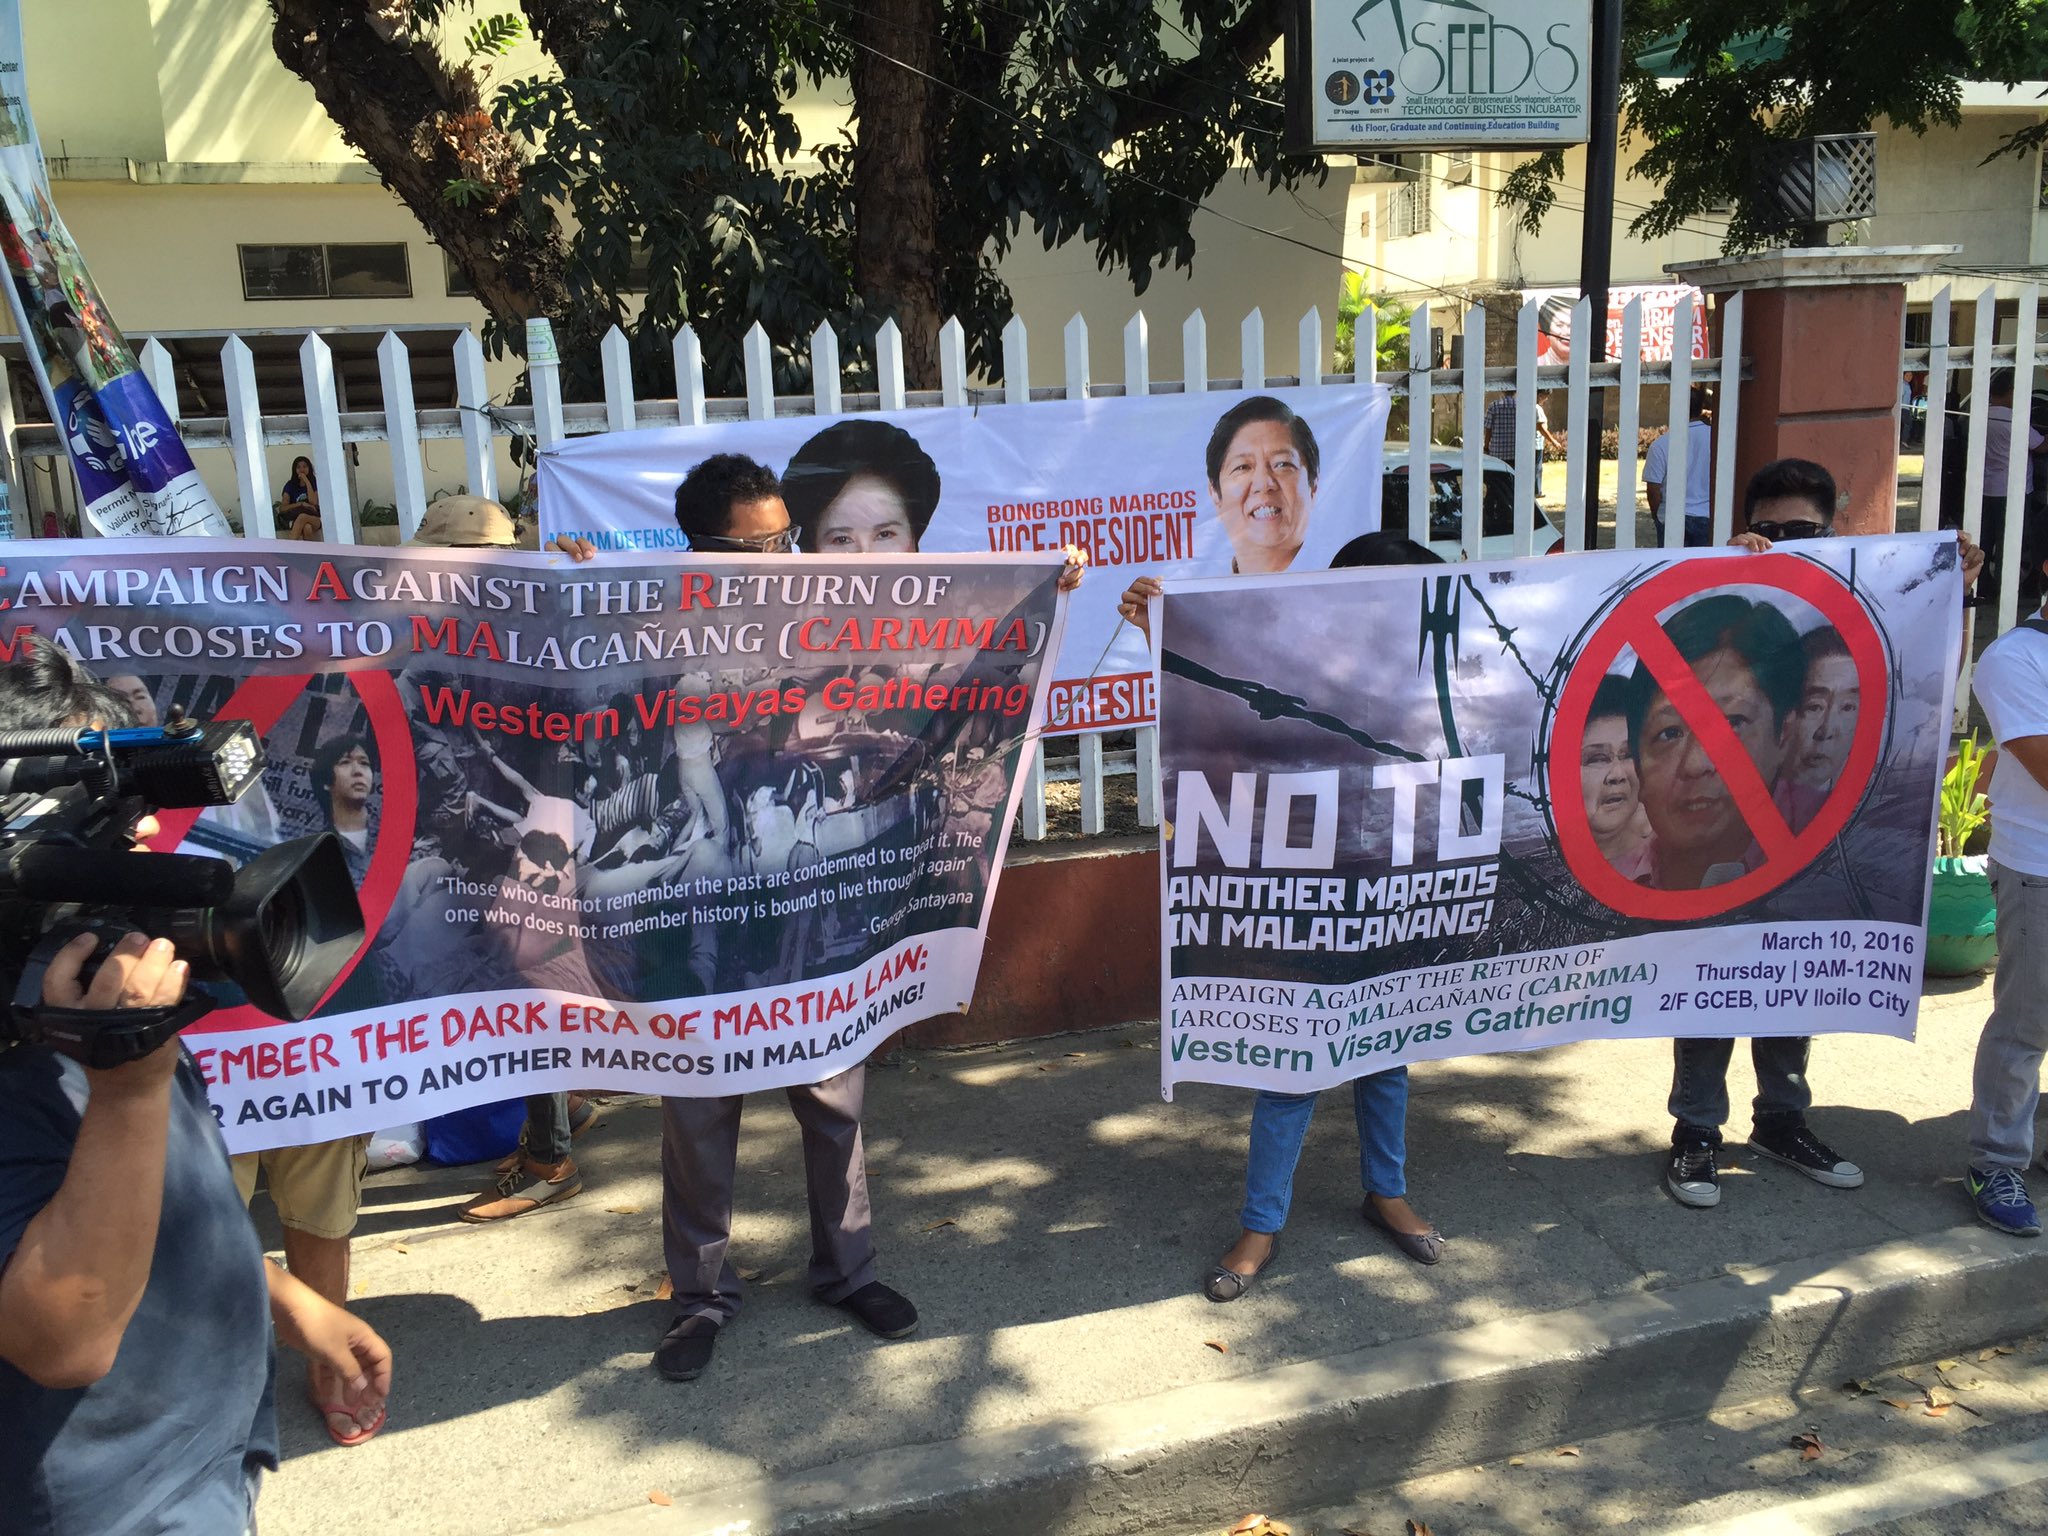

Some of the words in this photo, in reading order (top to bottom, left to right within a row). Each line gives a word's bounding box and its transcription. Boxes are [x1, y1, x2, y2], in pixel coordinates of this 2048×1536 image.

[1401, 105, 1469, 115] TECHNOLOGY
[1473, 104, 1522, 114] BUSINESS
[1525, 104, 1582, 114] INCUBATOR
[1406, 96, 1423, 105] Small
[1424, 96, 1454, 106] Enterprise
[1455, 96, 1467, 105] and
[1467, 95, 1513, 106] Entrepreneurial
[1514, 95, 1552, 105] Development
[1553, 95, 1577, 104] Services
[1350, 123, 1364, 132] 4th
[1365, 123, 1389, 133] Floor,
[1390, 122, 1427, 132] Graduate
[1427, 122, 1443, 131] and
[1527, 120, 1560, 131] Building
[95, 494, 131, 518] Permit
[106, 506, 140, 532] Validity
[987, 497, 1103, 523] BONGBONG
[1109, 490, 1197, 514] MARCOS
[615, 528, 690, 550] DEFENSO
[987, 510, 1197, 568] VICE-PRESIDENT
[0, 564, 288, 611] AMPAIGN
[305, 560, 546, 614] AGAINST
[560, 577, 665, 619] THE
[677, 571, 877, 611] RETURN
[890, 574, 952, 607] OF
[315, 620, 393, 658] TO
[409, 614, 765, 672] MALACAÑANG
[777, 614, 1048, 660] (CARMMA)
[419, 684, 621, 743] Western
[634, 686, 807, 731] Visayas
[822, 675, 1031, 717] Gathering
[1040, 677, 1157, 727] GRESIB
[1173, 768, 1340, 870] NO
[1371, 752, 1506, 868] TO
[501, 883, 538, 905] who
[541, 892, 602, 914] cannot
[606, 870, 691, 902] remember
[694, 875, 723, 897] the
[727, 872, 762, 896] past
[766, 871, 791, 889] are
[793, 847, 876, 884] condemned
[879, 847, 896, 865] to
[899, 834, 936, 864] repeat
[937, 831, 951, 849] it.
[955, 831, 983, 849] The
[1168, 874, 1346, 912] ANOTHER
[1355, 862, 1500, 912] MARCOS
[444, 907, 479, 923] one
[484, 906, 521, 926] who
[524, 912, 564, 936] does
[568, 923, 598, 940] not
[602, 900, 689, 930] remember
[692, 902, 750, 926] history
[754, 900, 767, 919] is
[771, 890, 818, 917] bound
[820, 886, 836, 905] to
[838, 881, 864, 902] live
[866, 867, 918, 896] through
[916, 862, 925, 877] it
[870, 904, 907, 936] George
[905, 890, 975, 916] Santayana
[1169, 912, 1210, 948] IN
[1220, 899, 1496, 952] MALACAÑANG!
[1761, 931, 1823, 951] March
[1829, 930, 1857, 953] 10,
[1864, 930, 1915, 955] 2016
[1171, 983, 1297, 1008] AMPAIGN
[1302, 975, 1411, 1010] AGAINST
[1416, 966, 1463, 989] THE
[1470, 951, 1569, 984] RETURN
[1573, 947, 1606, 966] OF
[1695, 959, 1787, 984] Thursday
[1803, 959, 1913, 984] 9AM-12NN
[193, 1032, 341, 1086] EMBER
[350, 1012, 430, 1066] THE
[439, 999, 549, 1051] DARK
[558, 1002, 635, 1038] ERA
[649, 1007, 704, 1041] OF
[712, 976, 861, 1042] MARTIAL
[861, 942, 931, 1014] LAW:
[1306, 1016, 1342, 1038] TO
[1346, 984, 1512, 1033] MALACAÑANG
[1518, 961, 1658, 1004] (CARMMA)
[1658, 990, 1689, 1012] 2/F
[1694, 989, 1759, 1012] GCEB,
[1764, 988, 1809, 1008] UPV
[1814, 986, 1862, 1007] Iloilo
[1868, 988, 1911, 1018] City
[236, 1084, 352, 1126] AGAIN
[361, 1074, 409, 1105] TO
[418, 1046, 573, 1093] ANOTHER
[581, 1046, 716, 1077] MARCOS
[724, 1047, 753, 1074] IN
[762, 981, 927, 1069] MALACAÑANG!
[1327, 1019, 1453, 1068] Visayas
[1464, 992, 1634, 1037] Gathering
